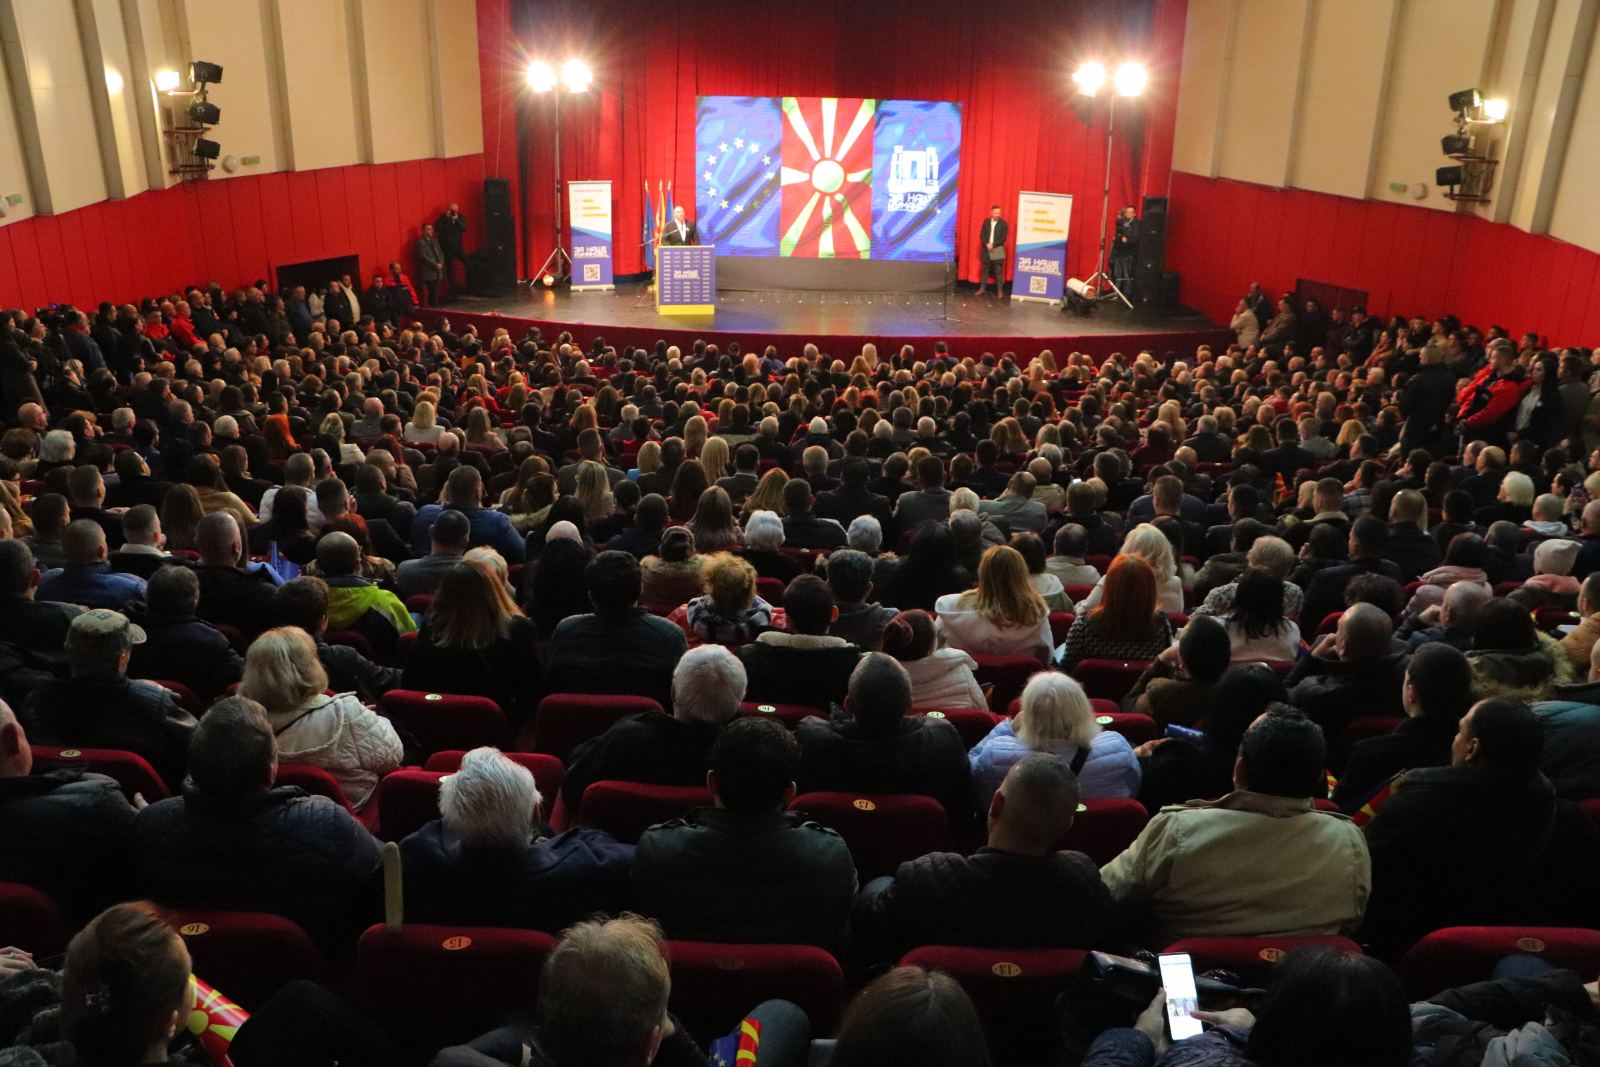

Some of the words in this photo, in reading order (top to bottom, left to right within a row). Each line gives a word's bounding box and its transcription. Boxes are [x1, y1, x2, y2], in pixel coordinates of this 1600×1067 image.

[859, 800, 868, 808] 15
[187, 924, 200, 933] 16
[450, 938, 462, 948] 15
[1267, 950, 1279, 961] 12
[999, 964, 1011, 975] 13
